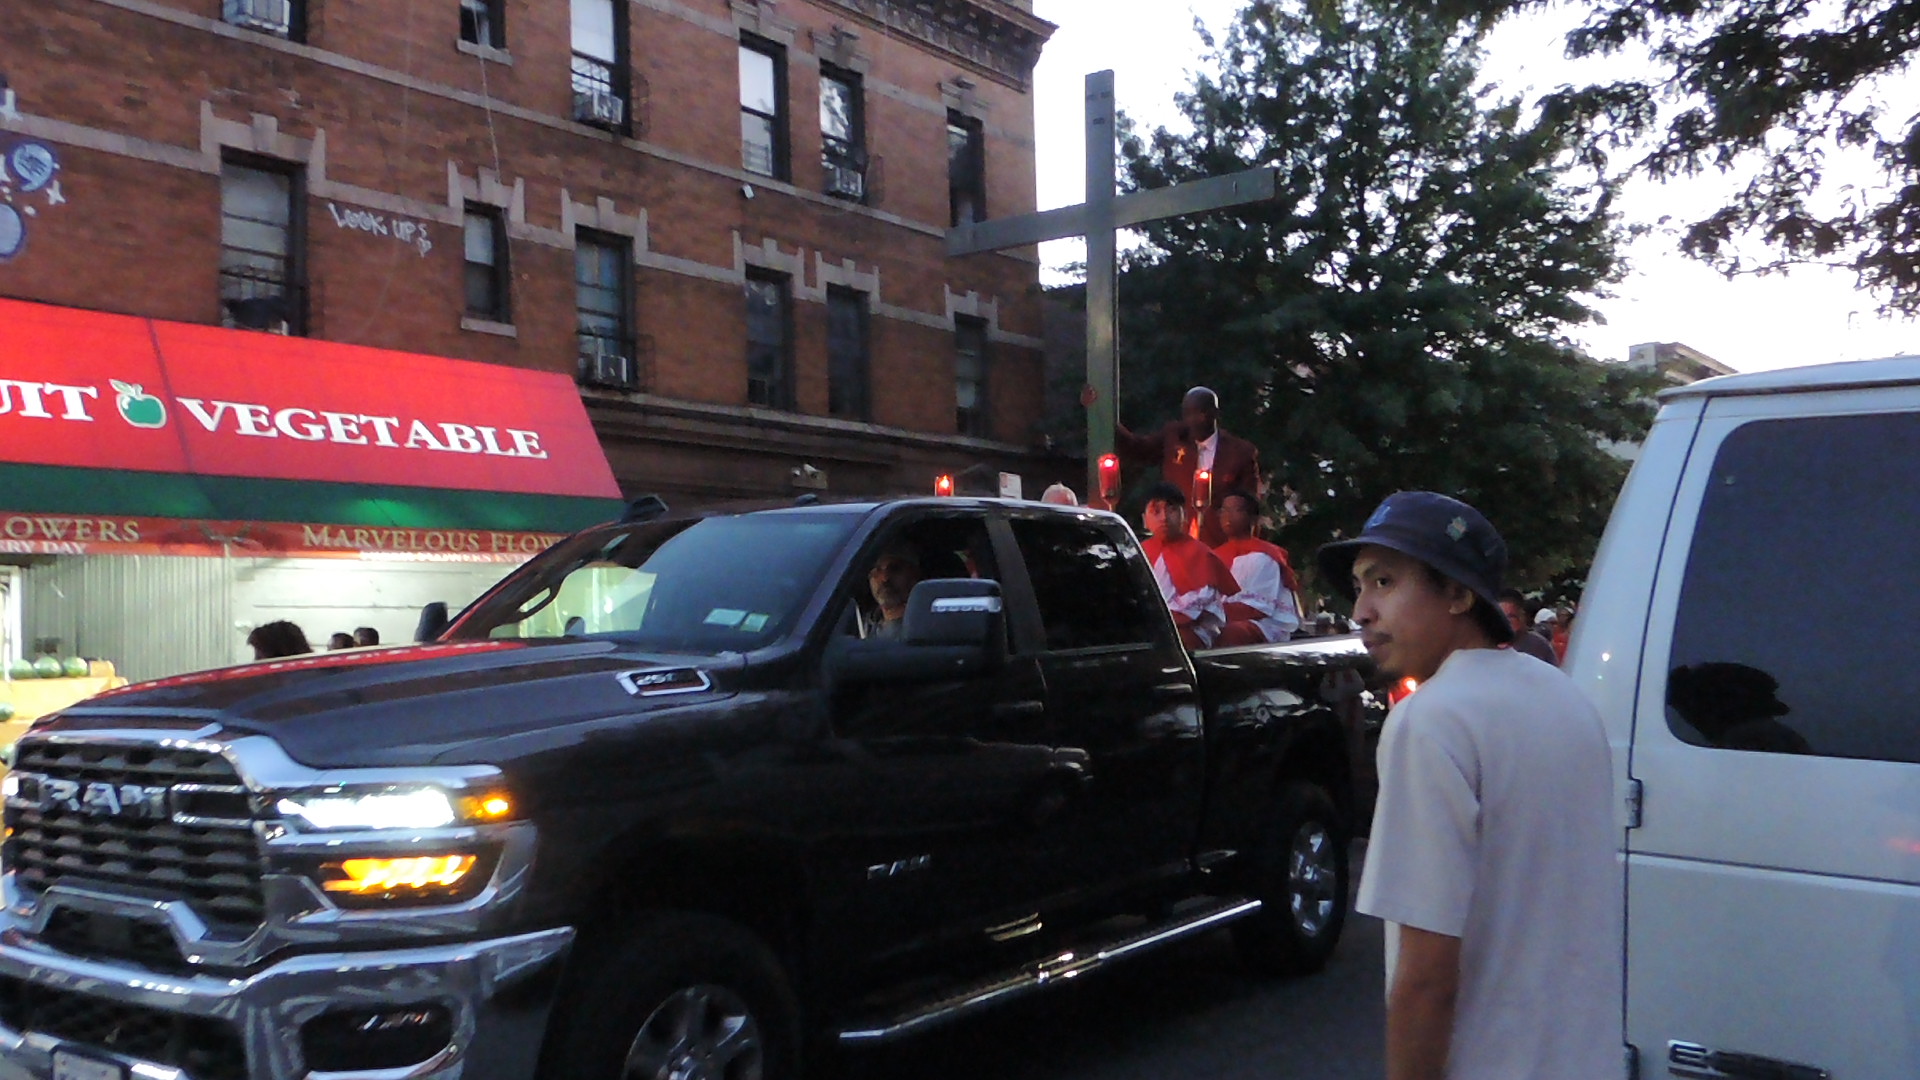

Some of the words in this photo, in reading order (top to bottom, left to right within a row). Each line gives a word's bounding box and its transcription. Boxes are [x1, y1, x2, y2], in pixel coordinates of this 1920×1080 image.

[176, 397, 548, 459] VEGETABLE
[0, 516, 141, 542] OWERS
[302, 525, 480, 551] MARVELOUS
[491, 532, 569, 553] FLOW
[41, 541, 88, 554] DAY
[38, 778, 167, 820] RAM
